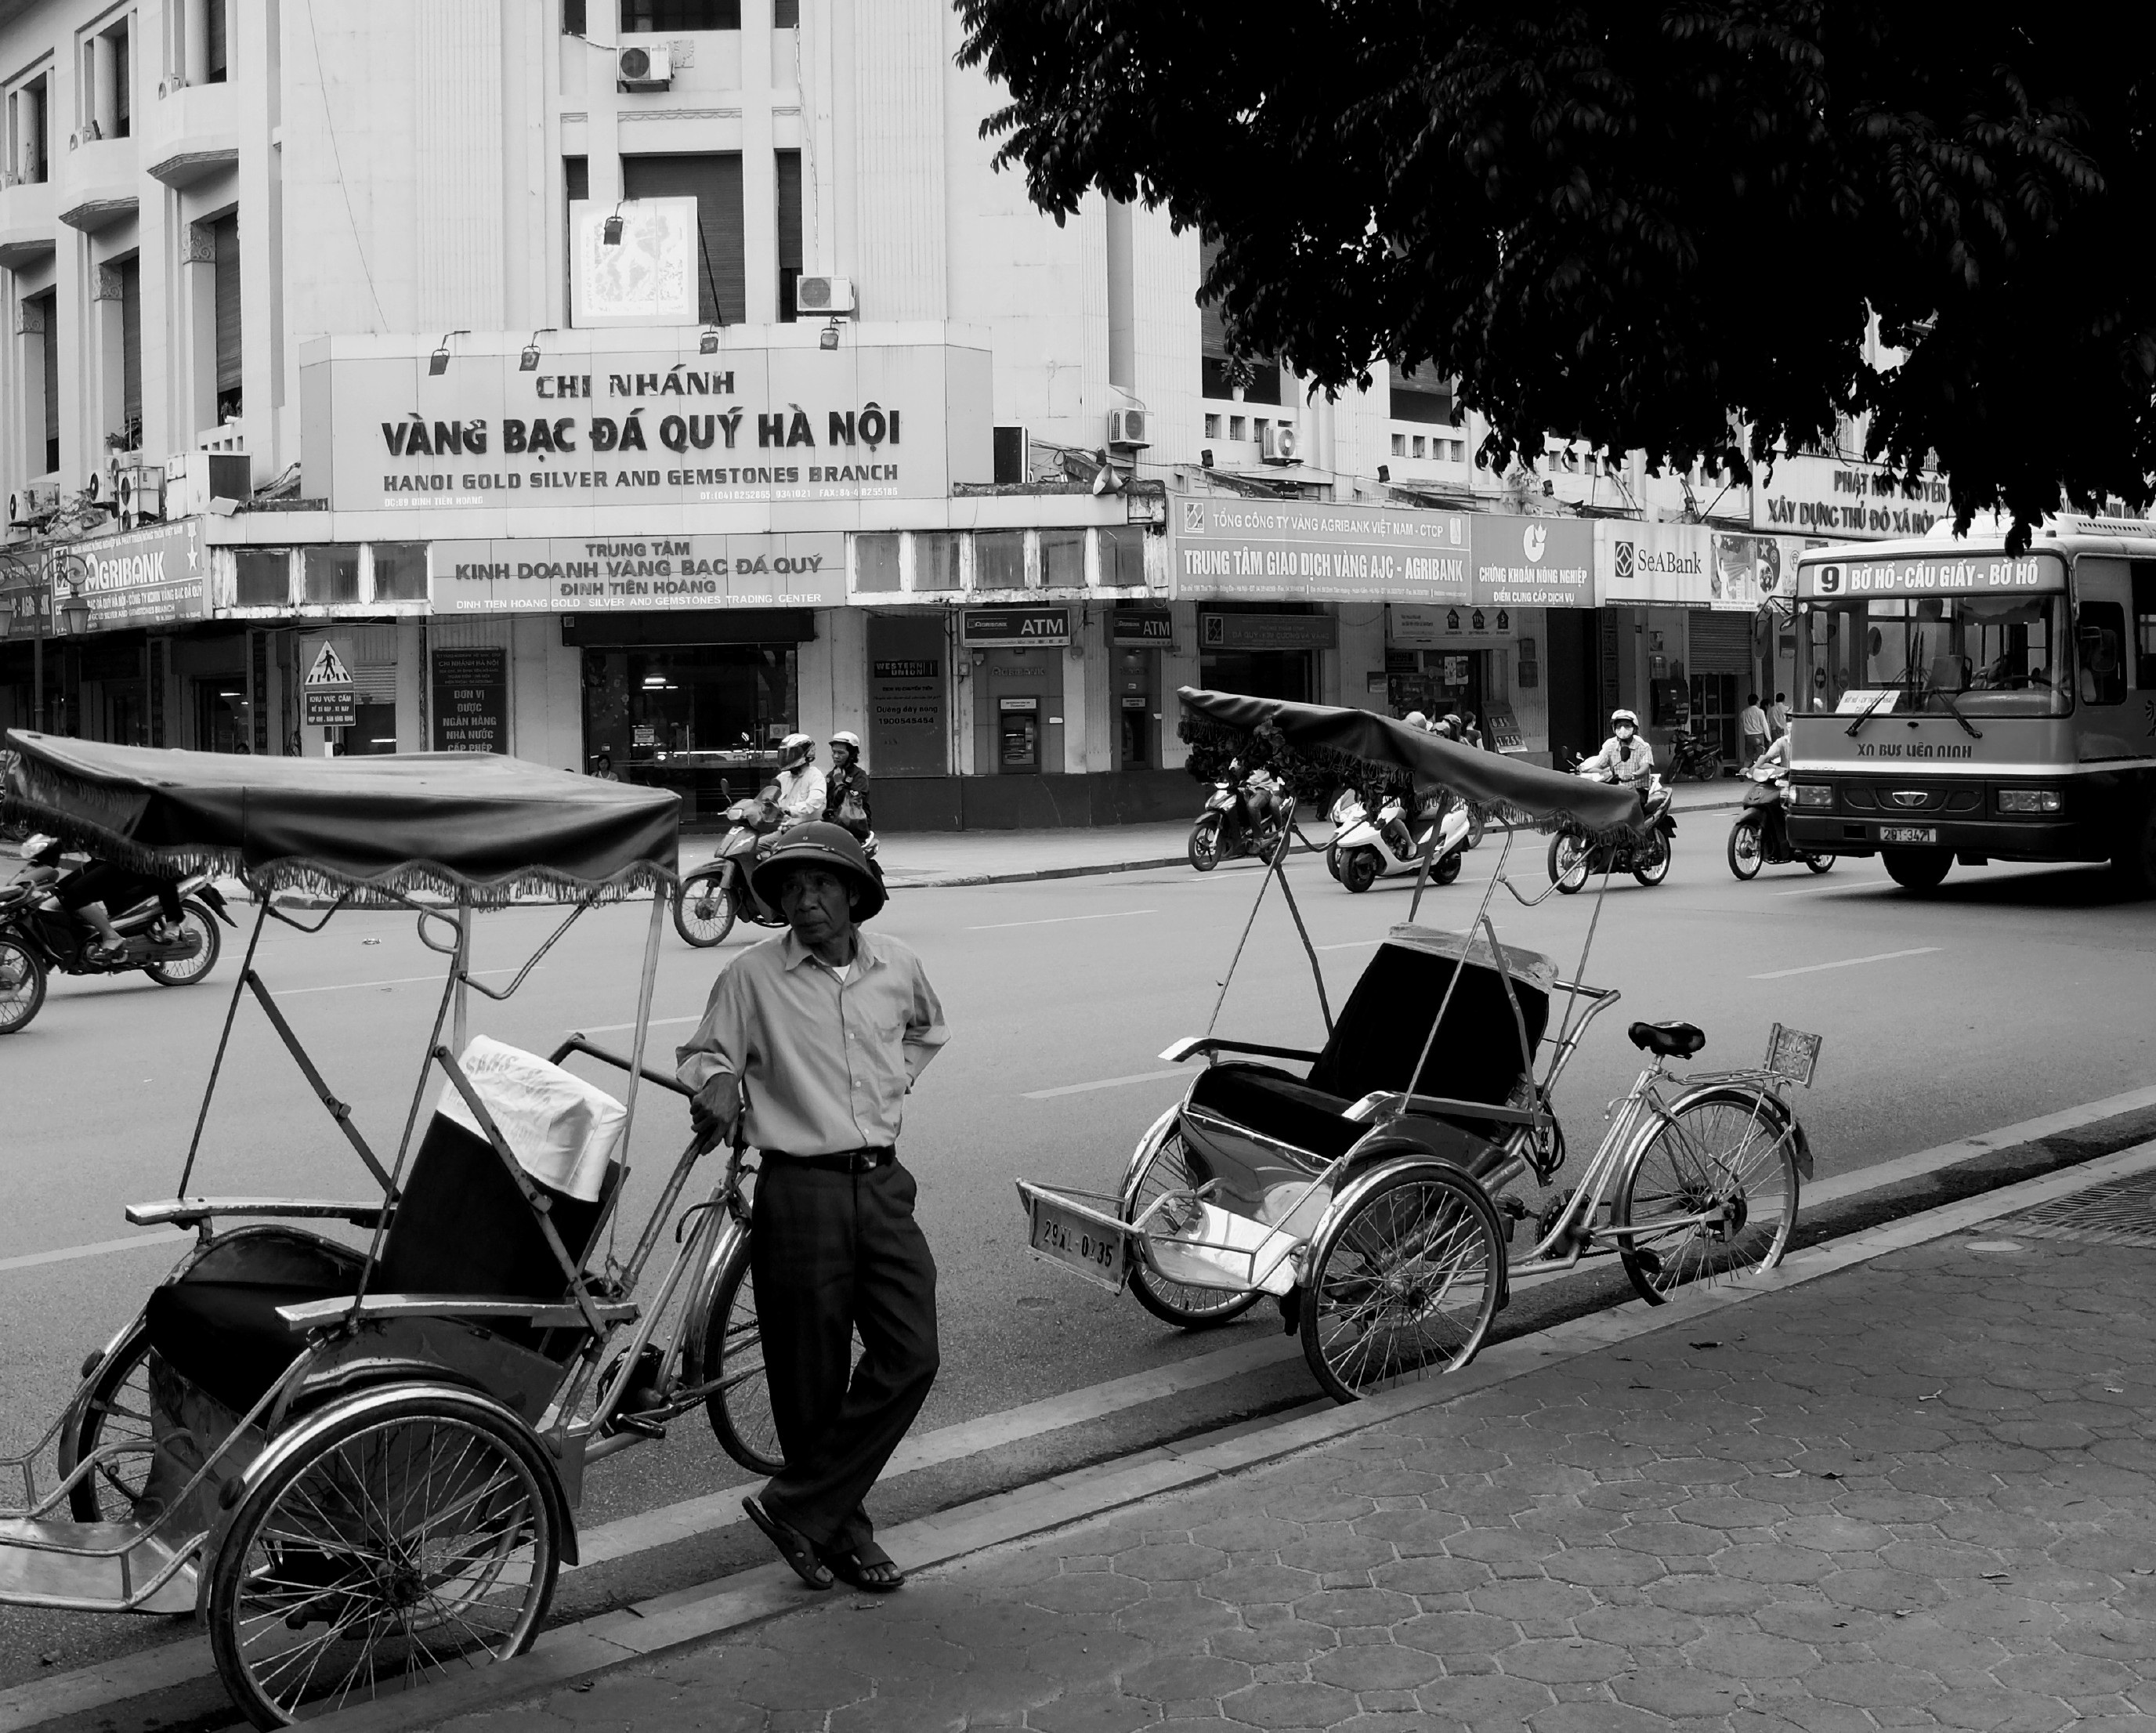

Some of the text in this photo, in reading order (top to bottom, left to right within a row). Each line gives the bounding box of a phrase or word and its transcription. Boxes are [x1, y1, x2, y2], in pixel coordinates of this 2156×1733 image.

[537, 364, 735, 398] CHI NHÁNH
[382, 402, 899, 462] VÀNG BẠC ĐÁ QUÝ HÀ NỘI
[384, 464, 898, 491] HANOI GOLD SILVER AND GEMSTONES BRANCH
[1213, 508, 1444, 538] TỔNG CÔNG TY VÀNG AGRIBANK VIỆT NAM CTCP
[1768, 495, 1796, 523] XÂY
[1800, 500, 1839, 533] DỰNG
[1841, 501, 1866, 529] THỦ
[585, 540, 690, 559] TRUNG TÂM
[1637, 548, 1702, 575] SeABank
[85, 552, 165, 592] AGRIBANK
[455, 552, 823, 581] KINH DOANH VÀNG BẠC ĐÁ QUÝ
[1184, 549, 1231, 576] TRUNG
[1233, 546, 1263, 576] TÂM
[1266, 551, 1298, 577] GIAO
[1300, 552, 1331, 581] DỊCH
[1333, 549, 1367, 579] VÀNG
[1370, 555, 1394, 579] AJC
[1405, 556, 1463, 582] AGRIBANK
[1478, 563, 1587, 588] CHỨNG KHOÁN NÔNG NGHIỆP
[1821, 566, 1839, 592] 9
[1851, 563, 1872, 590] BỜ
[1874, 560, 1896, 589] HỒ
[1905, 558, 1936, 588] CẦU
[1939, 559, 1976, 588] GIẤY
[1989, 559, 2012, 586] BỜ
[2016, 557, 2038, 585] HỒ
[560, 578, 716, 596] ĐINH TIÊN HOÀNG
[1492, 586, 1575, 605] ĐIỂM CUNG CẤP DỊCH VỤ
[456, 593, 822, 610] DINH TIEN HOANG GOLD SILVER AND GEMSTONES TRADING CENTER
[1021, 619, 1063, 635] ATM
[1143, 620, 1170, 635] ATM
[877, 662, 923, 671] WESTERN
[1879, 743, 1902, 758] BUS
